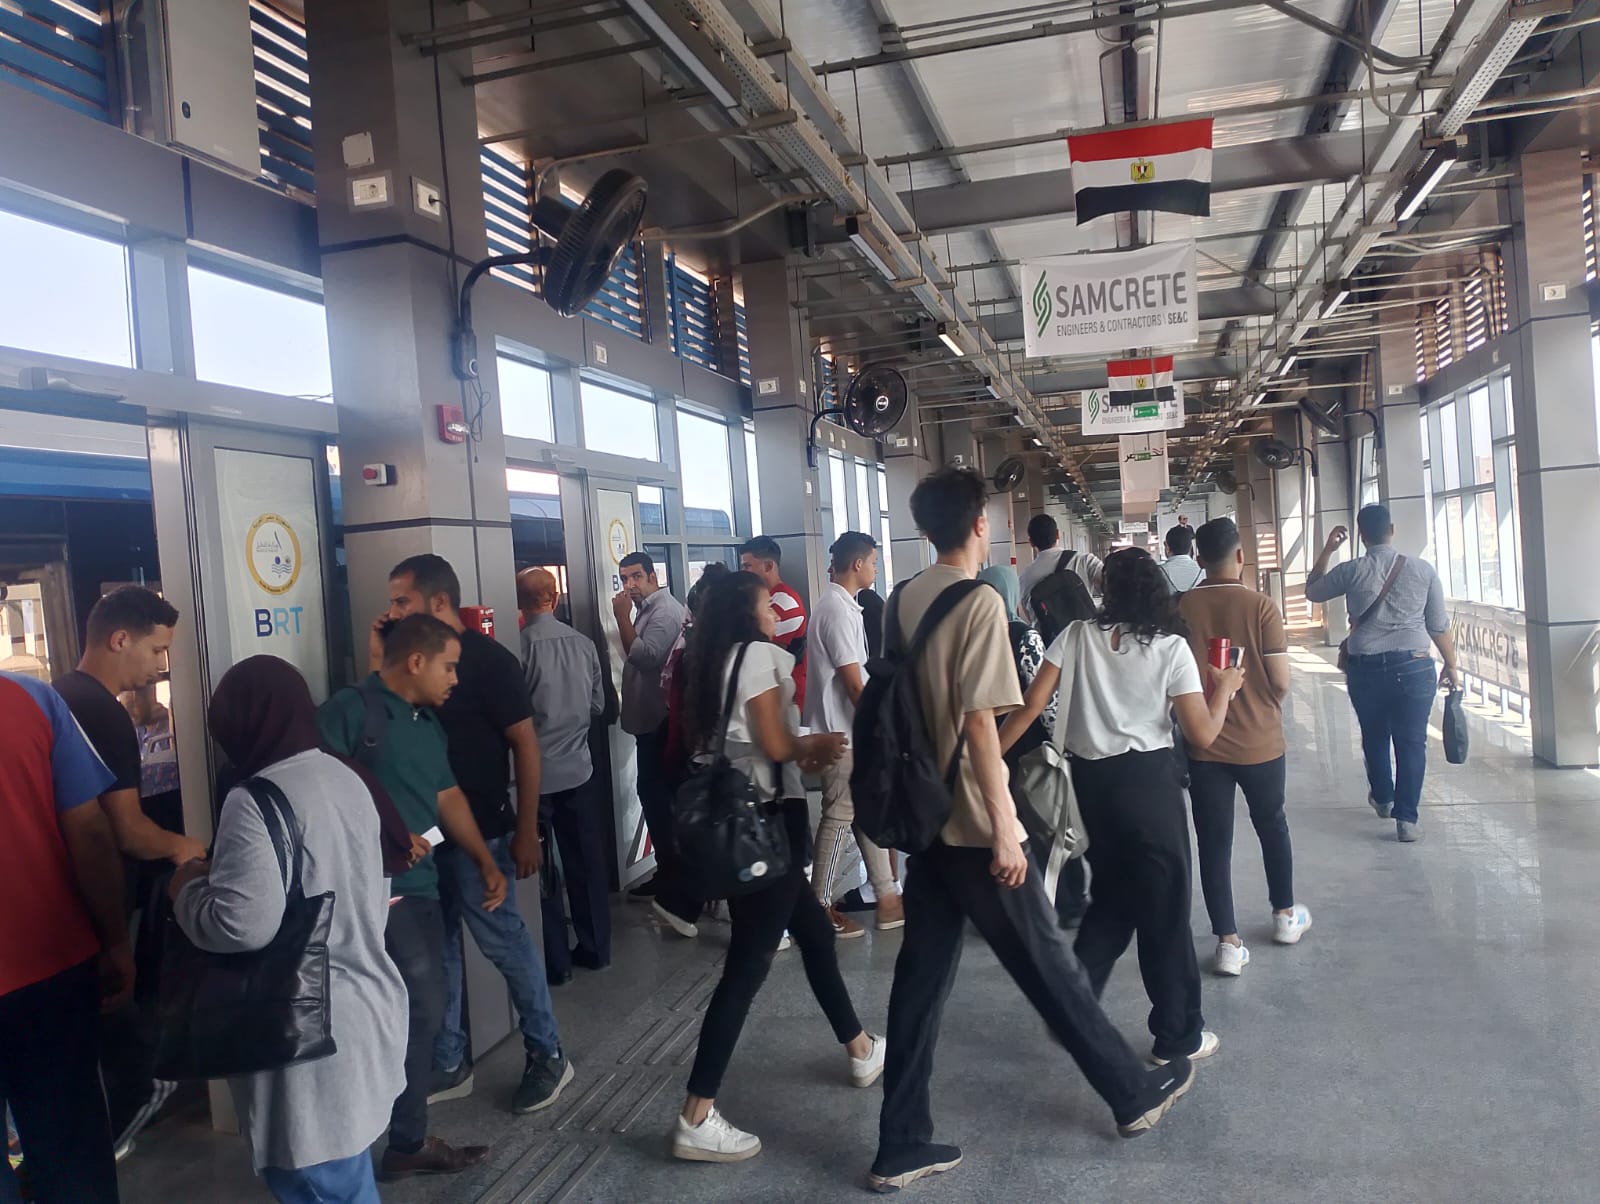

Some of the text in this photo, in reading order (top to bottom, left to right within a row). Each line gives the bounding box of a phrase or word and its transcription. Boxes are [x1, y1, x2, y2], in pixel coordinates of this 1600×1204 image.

[1056, 271, 1187, 318] SAMCRETE
[1056, 321, 1098, 337] ENGINEERS
[1100, 320, 1106, 333] &
[1107, 314, 1162, 332] CONTRACTORS
[1167, 311, 1188, 325] SE&C
[254, 606, 304, 637] BRT
[1459, 621, 1519, 669] SAMCRETE
